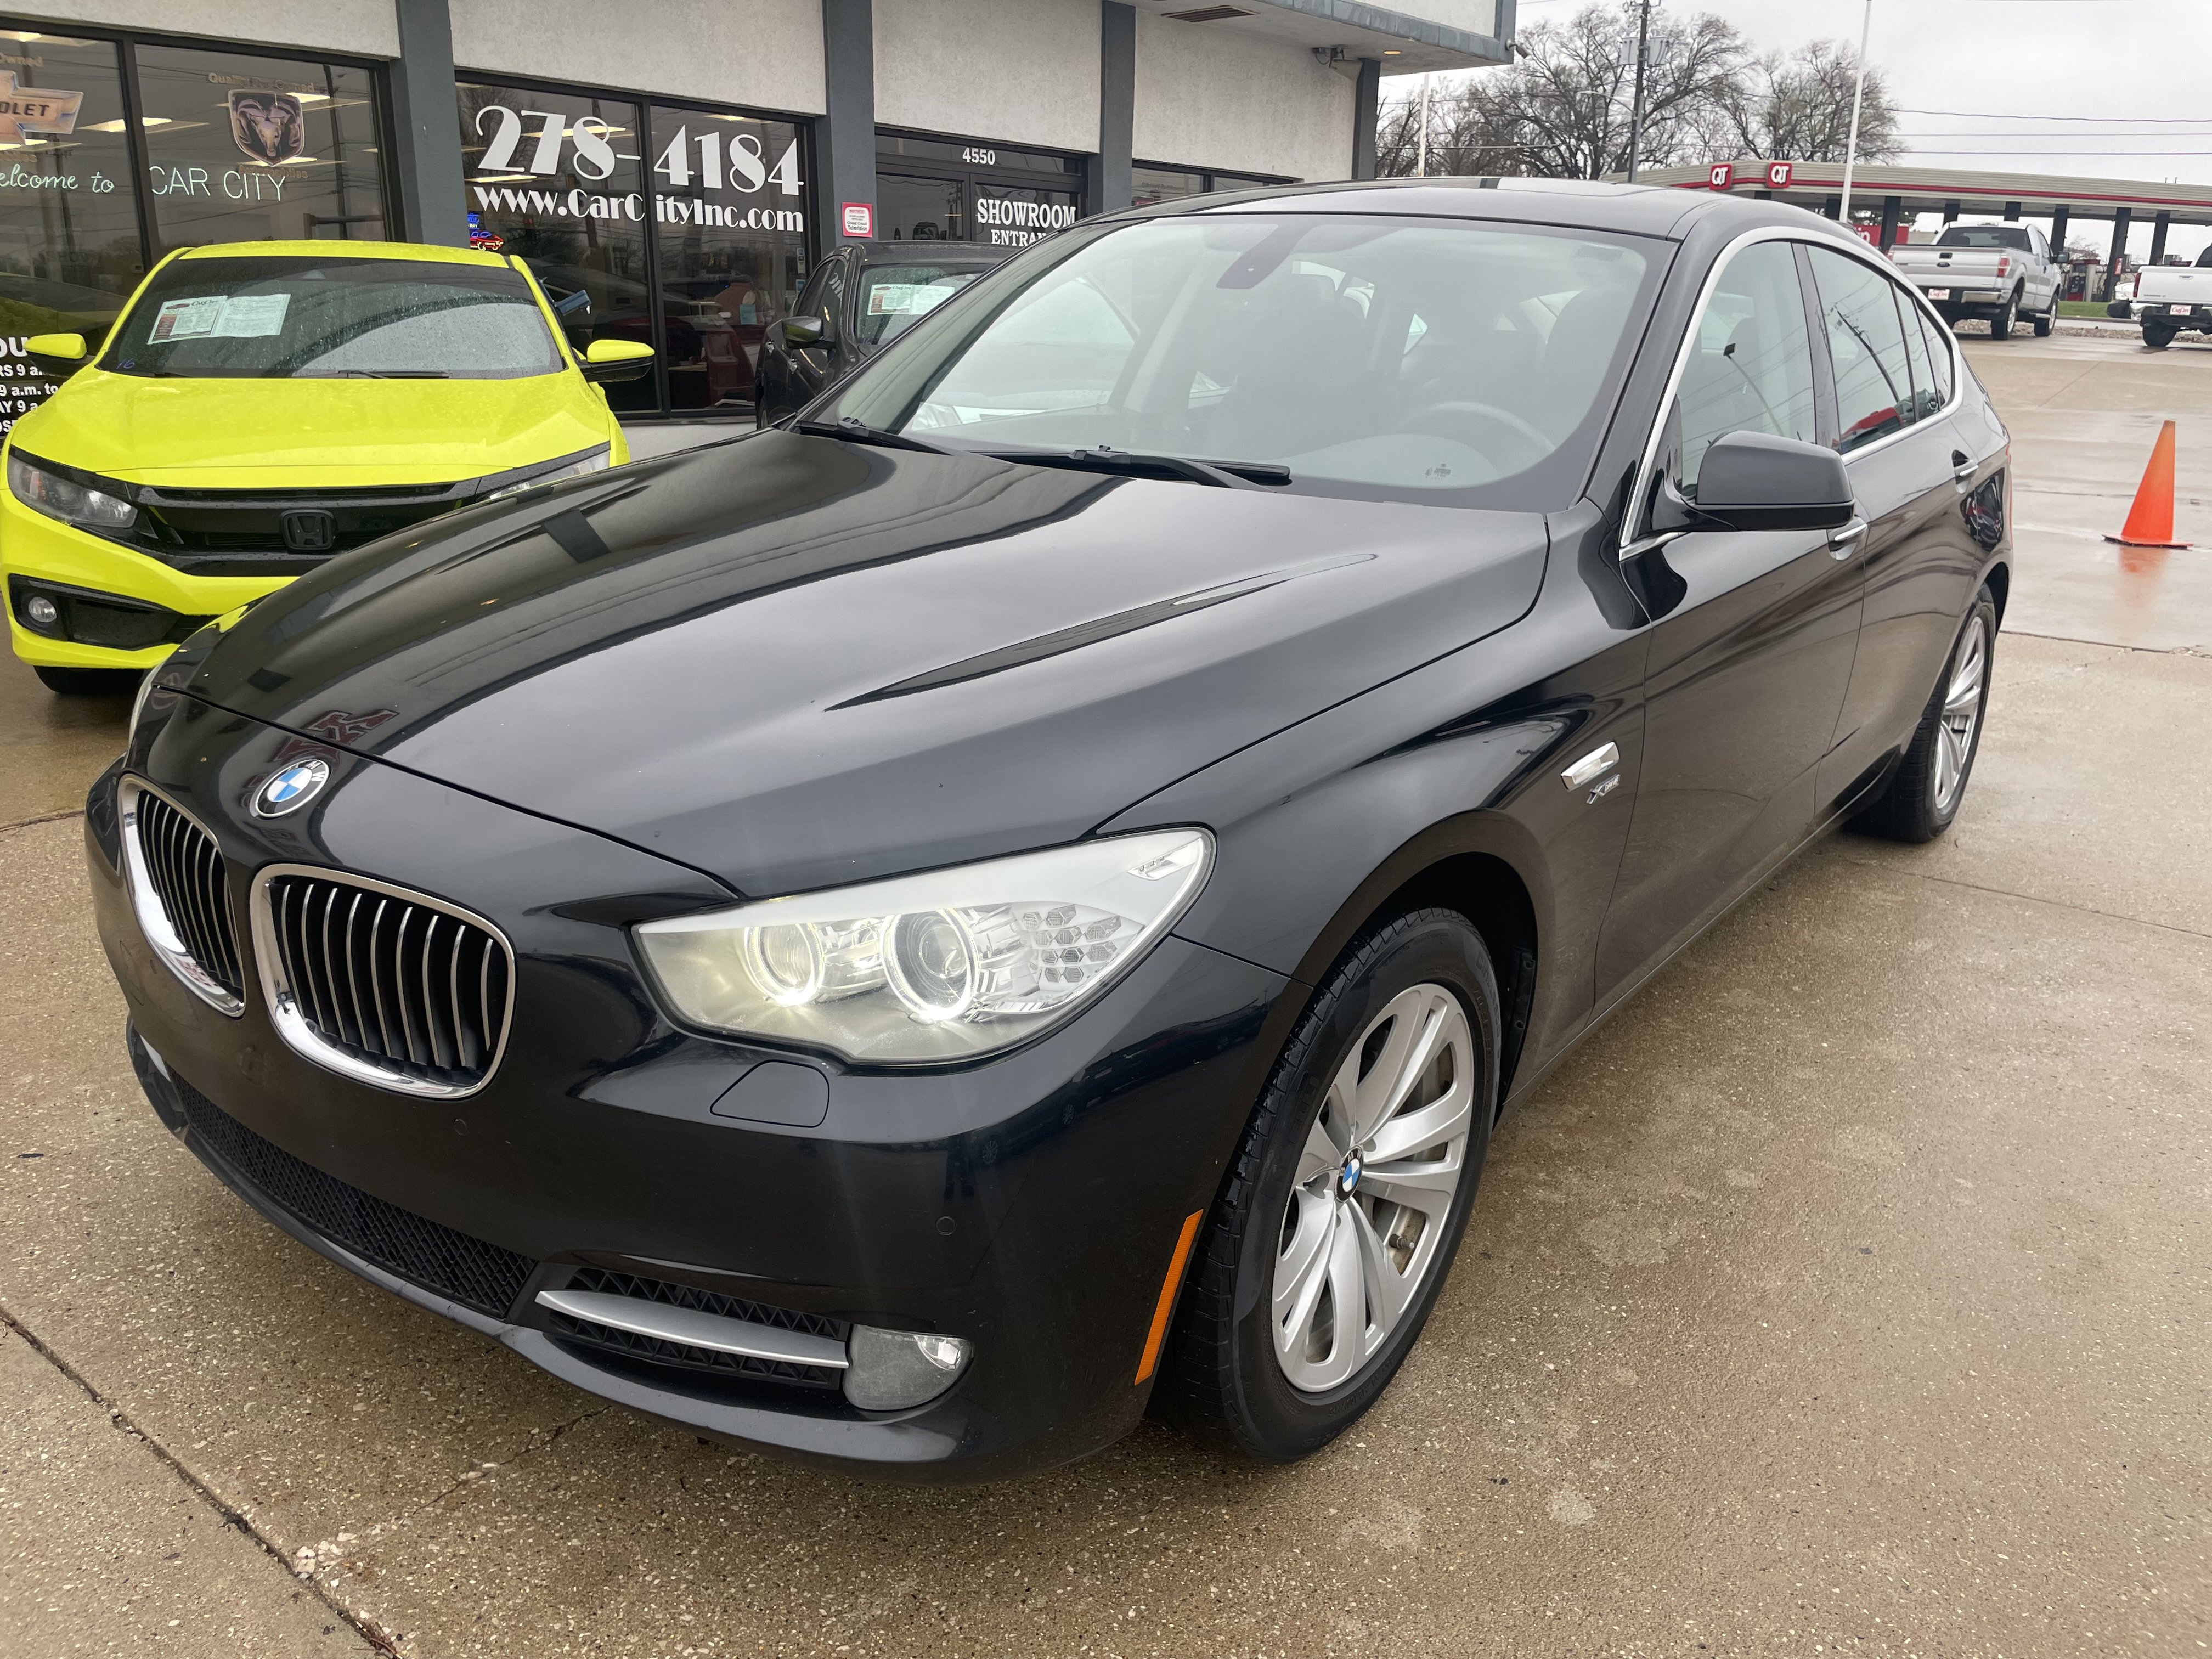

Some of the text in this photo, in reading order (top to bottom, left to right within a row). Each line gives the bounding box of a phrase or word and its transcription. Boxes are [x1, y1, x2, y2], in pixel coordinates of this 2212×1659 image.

[962, 147, 996, 165] 4550
[238, 165, 308, 179] Automobiles
[1711, 167, 1728, 185] QT
[1771, 165, 1789, 184] QT
[91, 171, 115, 193] to
[149, 166, 211, 196] CAR
[223, 170, 286, 201] CITY
[977, 198, 1076, 229] SHOWROOM
[17, 366, 26, 377] 9
[12, 386, 42, 397] a.m.
[45, 383, 59, 396] to
[17, 400, 26, 414] 9
